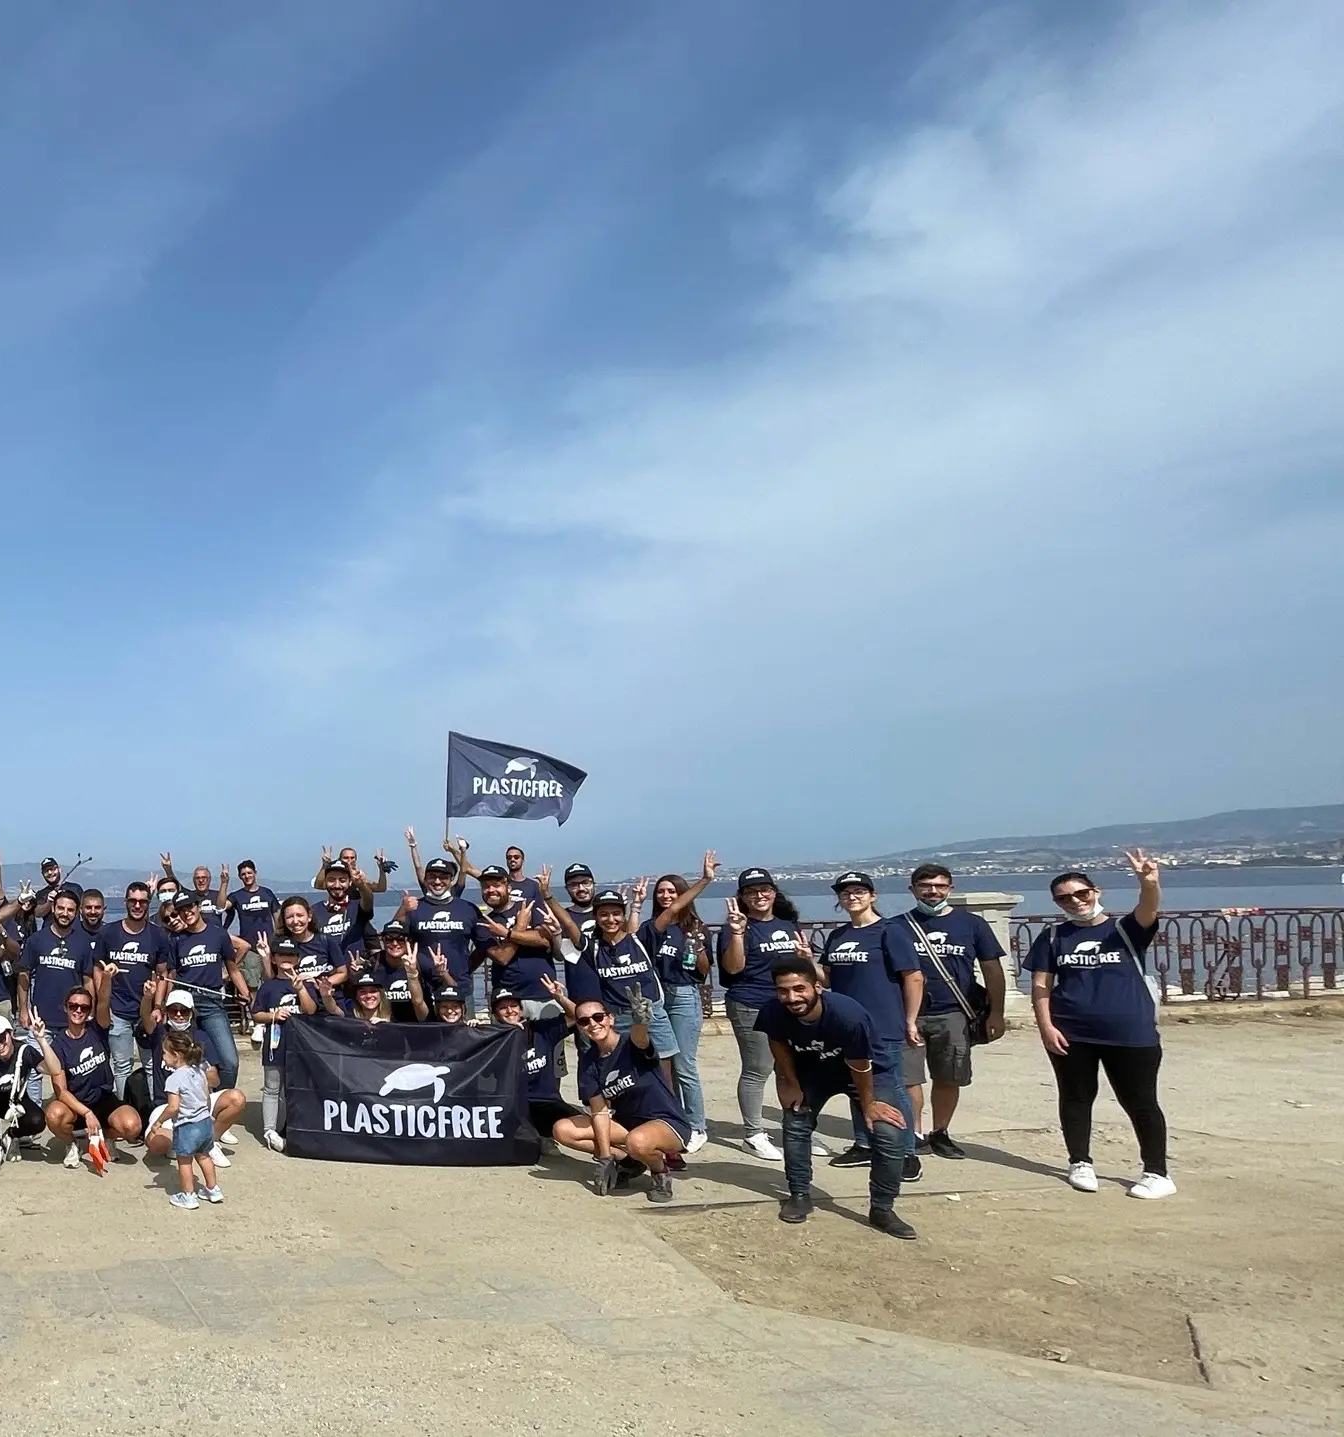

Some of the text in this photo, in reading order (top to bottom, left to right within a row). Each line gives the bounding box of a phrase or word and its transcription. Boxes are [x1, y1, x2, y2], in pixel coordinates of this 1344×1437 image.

[473, 777, 564, 798] PLASTICFREE
[418, 922, 464, 930] PLASTICFREE
[180, 954, 218, 966] LASTICFREE
[1057, 952, 1121, 965] PLASTICREE
[598, 961, 649, 977] PLASTICFREE
[323, 1100, 504, 1138] PLASTICFREE
